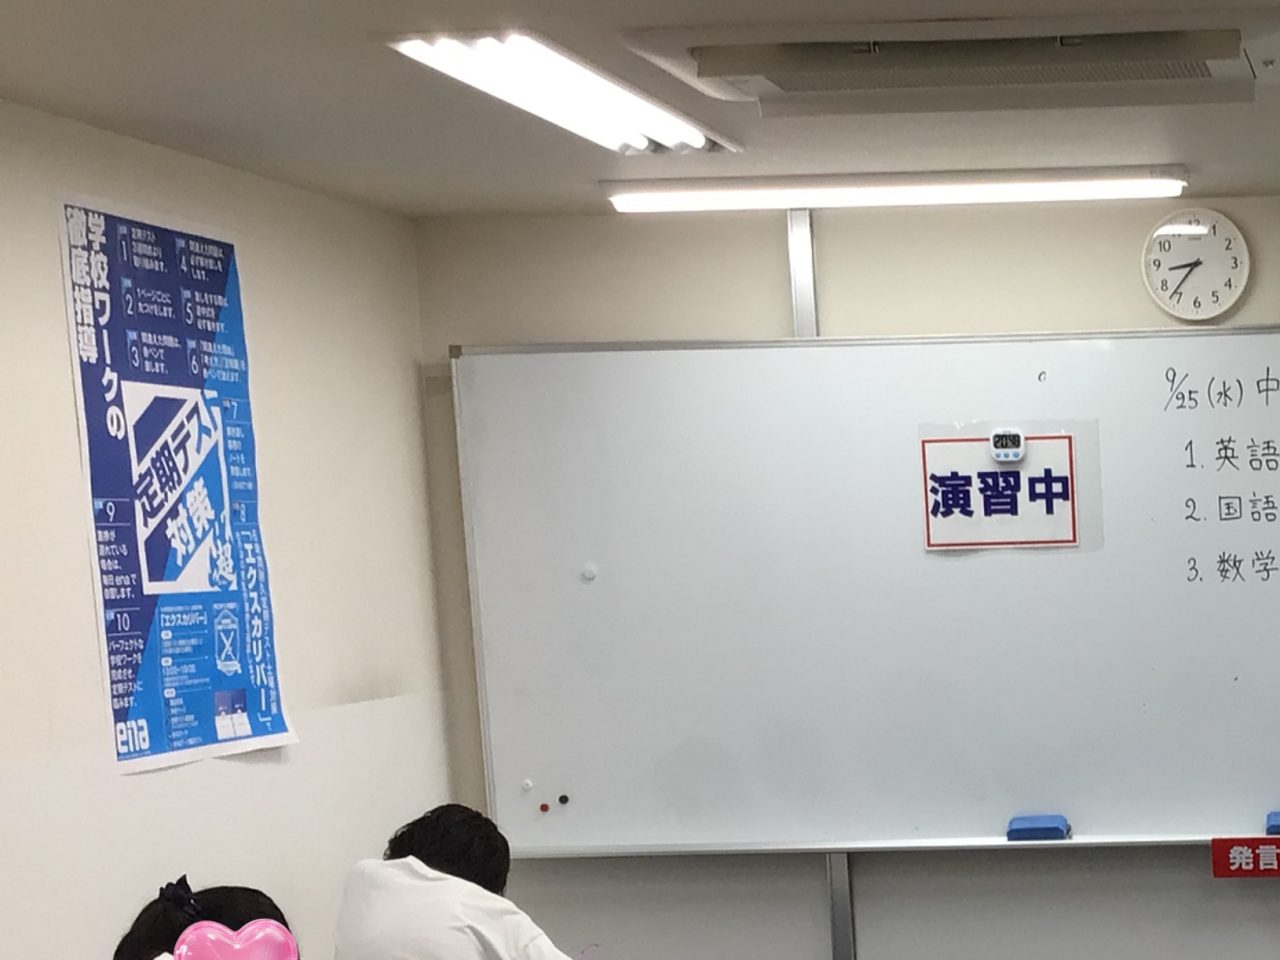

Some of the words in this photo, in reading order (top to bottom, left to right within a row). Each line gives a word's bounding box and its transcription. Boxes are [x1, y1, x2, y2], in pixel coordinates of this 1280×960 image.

[88, 212, 126, 440] 学校ワークの
[929, 467, 1071, 519] 演習中
[166, 477, 215, 567] 対策
[117, 613, 130, 631] 10
[116, 718, 150, 753] ena
